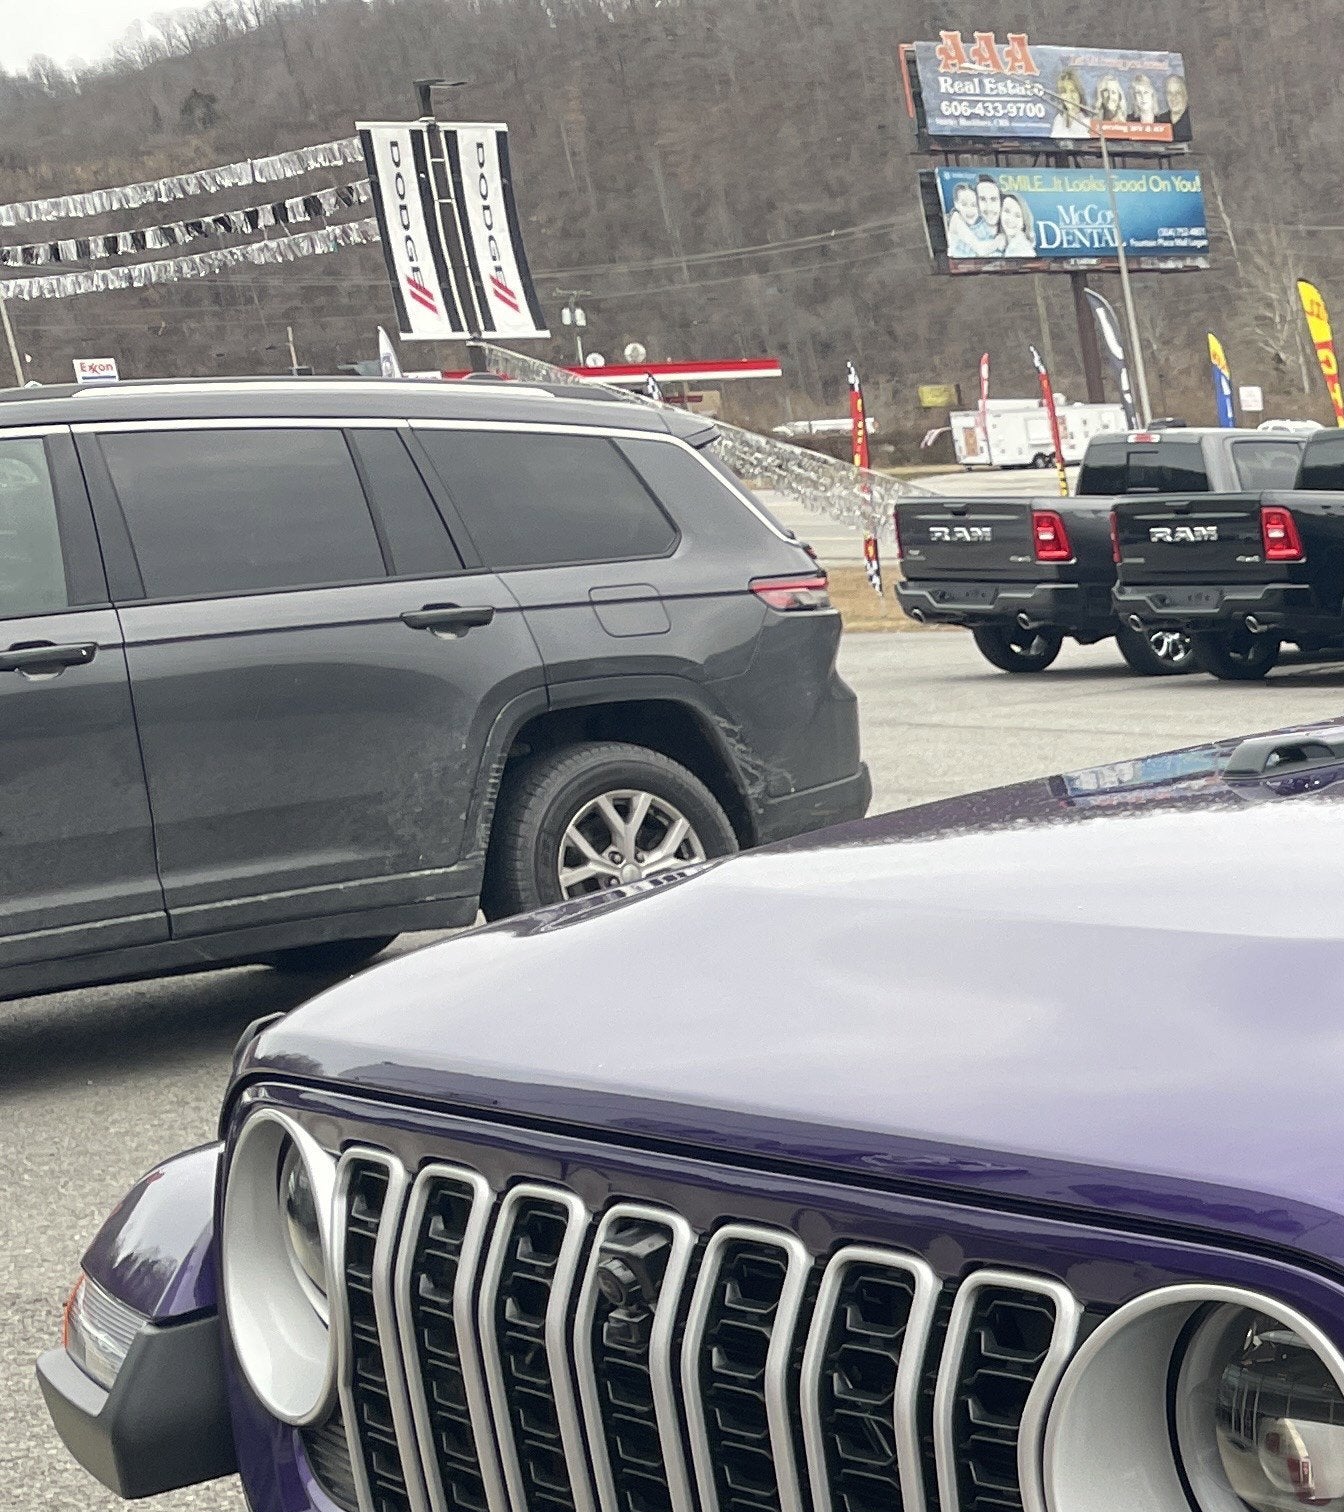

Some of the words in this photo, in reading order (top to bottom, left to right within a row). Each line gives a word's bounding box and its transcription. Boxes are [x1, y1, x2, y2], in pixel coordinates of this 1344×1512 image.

[935, 31, 1040, 76] AAA
[938, 76, 980, 94] Real
[984, 78, 1045, 97] Estate
[940, 100, 1046, 118] 606-433-9700
[1065, 174, 1106, 192] Looks
[1148, 175, 1172, 193] On
[1171, 174, 1202, 192] You!
[389, 140, 426, 290] DODGE
[475, 141, 508, 289] DODGE
[79, 361, 114, 375] Exxon
[928, 526, 992, 542] RAM
[1149, 525, 1218, 542] RAM
